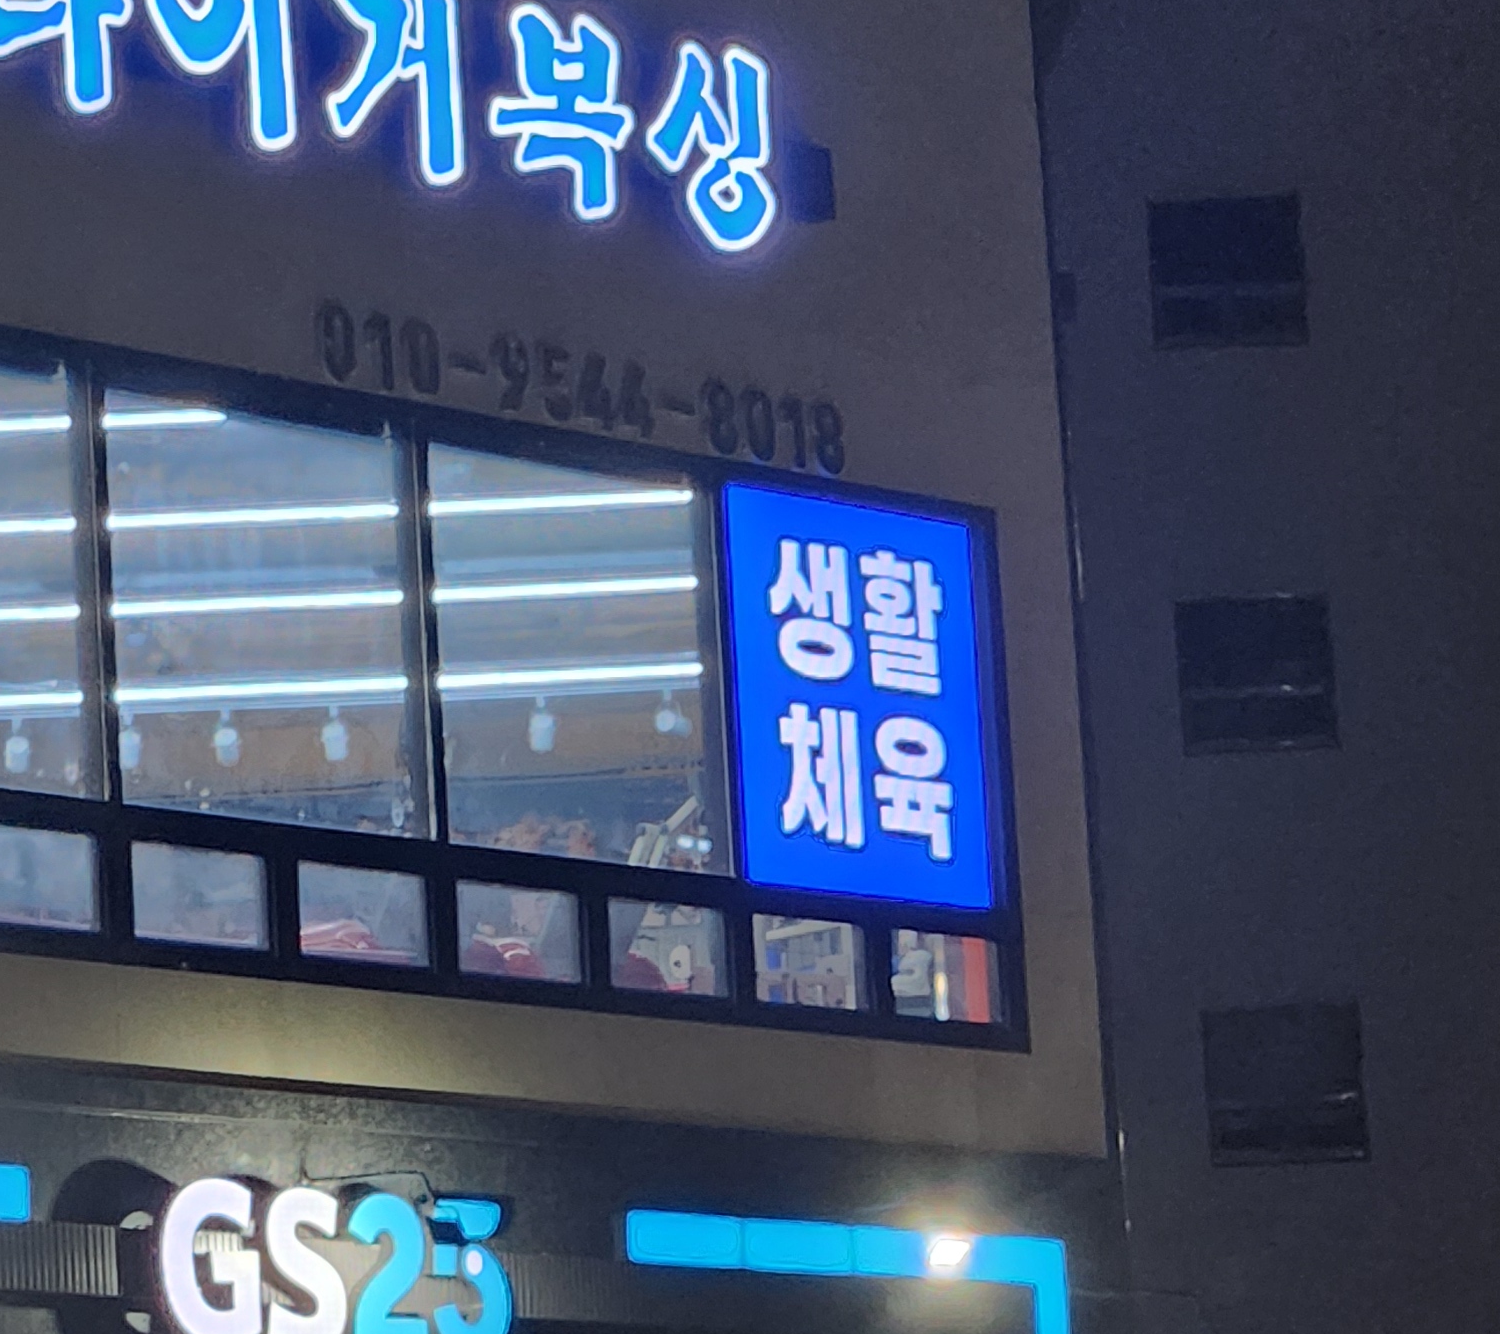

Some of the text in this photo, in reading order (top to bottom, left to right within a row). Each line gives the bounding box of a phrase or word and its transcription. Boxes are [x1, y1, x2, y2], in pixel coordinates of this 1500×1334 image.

[314, 298, 846, 476] 010-9544-8018
[768, 537, 944, 697] 생활
[778, 702, 957, 863] 체육
